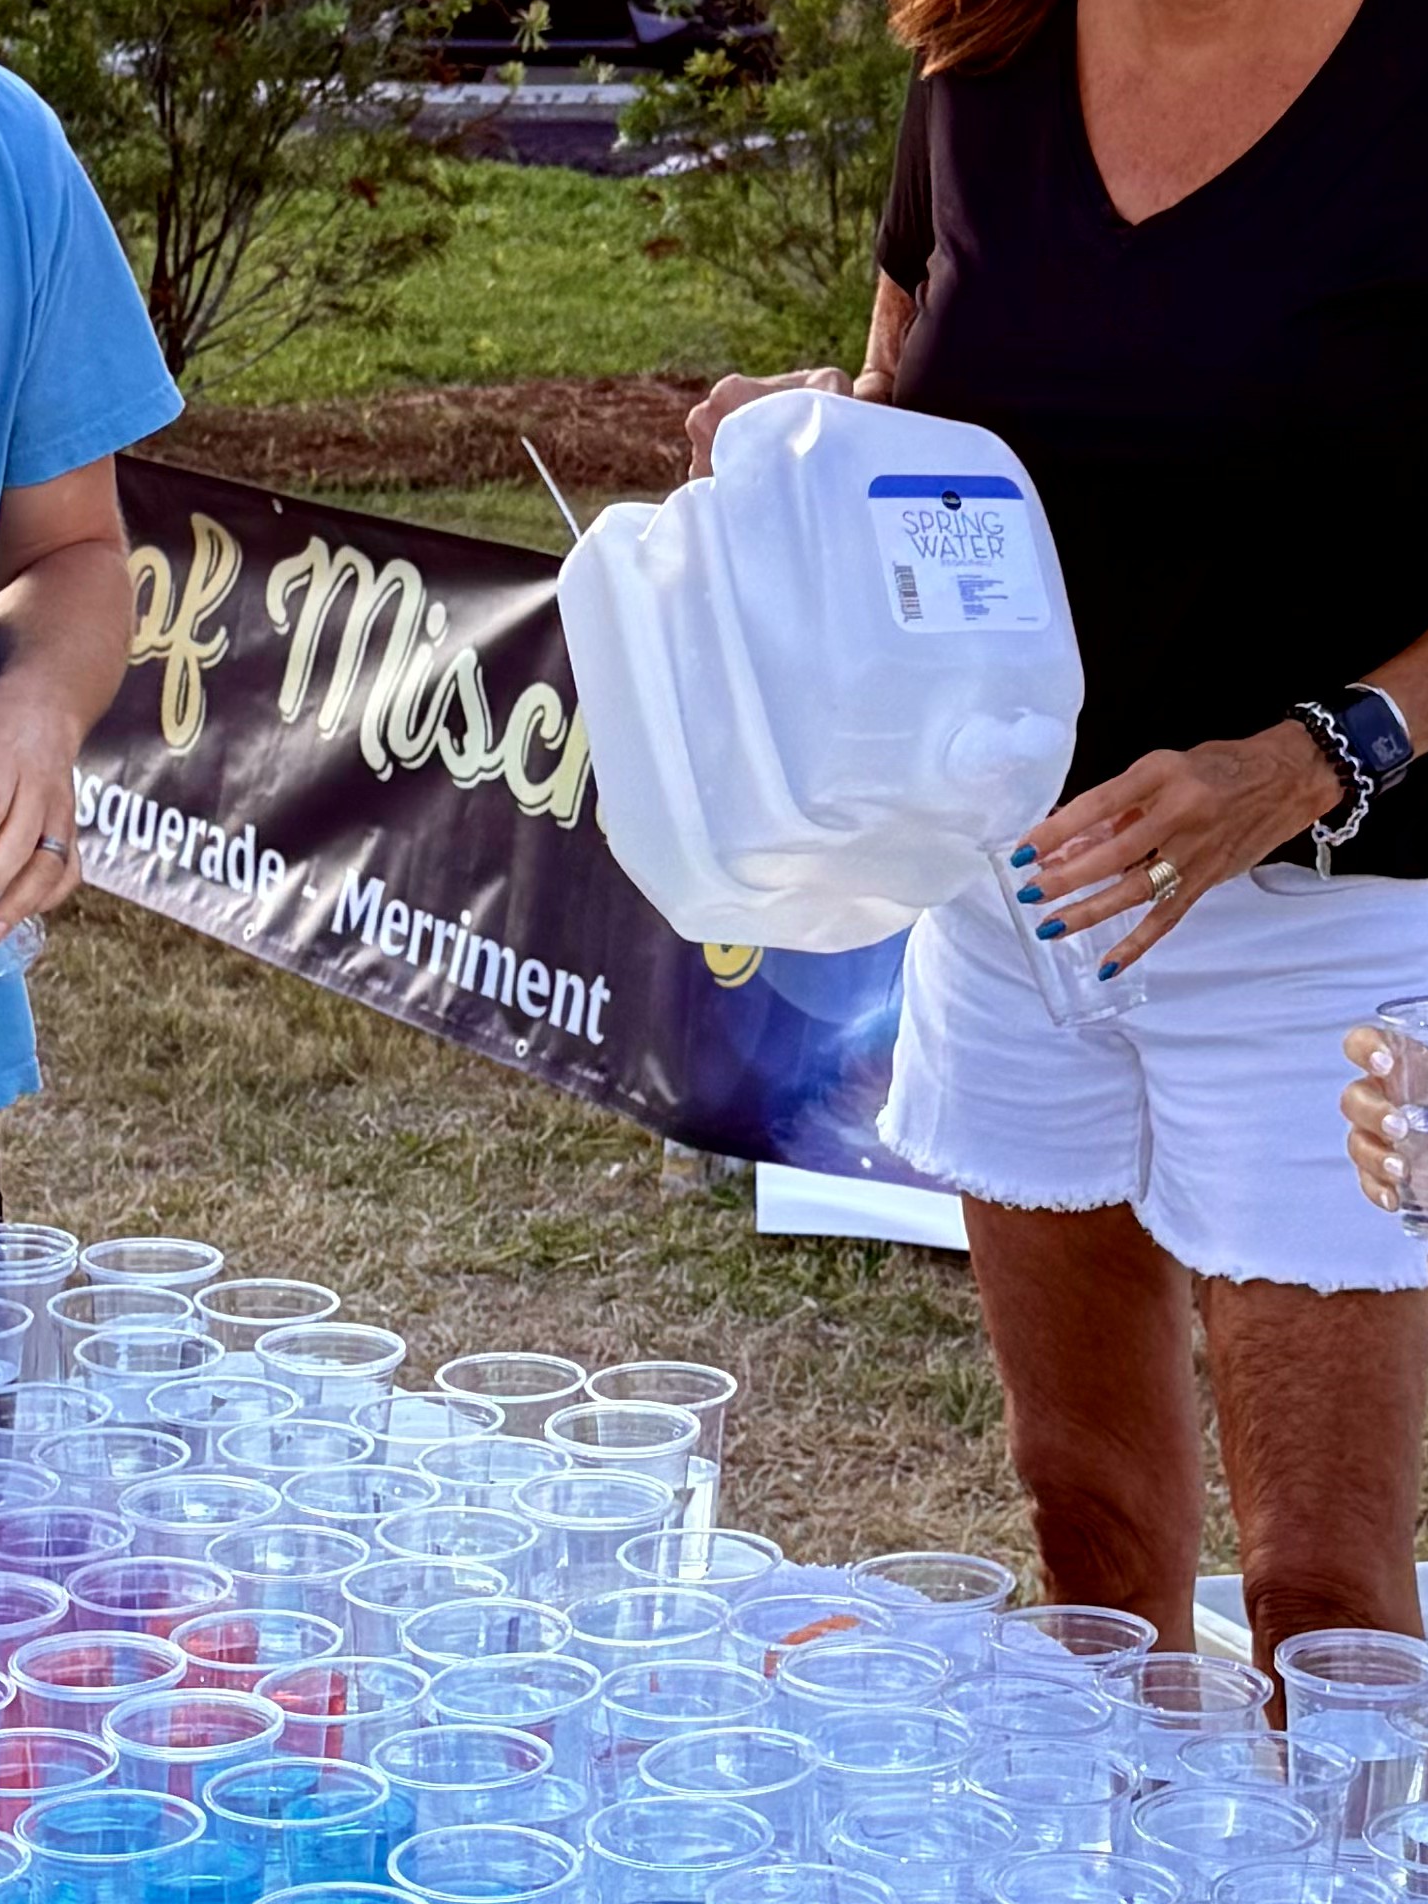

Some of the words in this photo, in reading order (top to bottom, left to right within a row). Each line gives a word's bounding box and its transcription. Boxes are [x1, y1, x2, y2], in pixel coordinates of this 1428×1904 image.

[902, 509, 1005, 536] SPRING
[909, 534, 1005, 560] WATER
[128, 512, 243, 757] of
[72, 765, 286, 903] squerade
[332, 870, 611, 1045] Merriment
